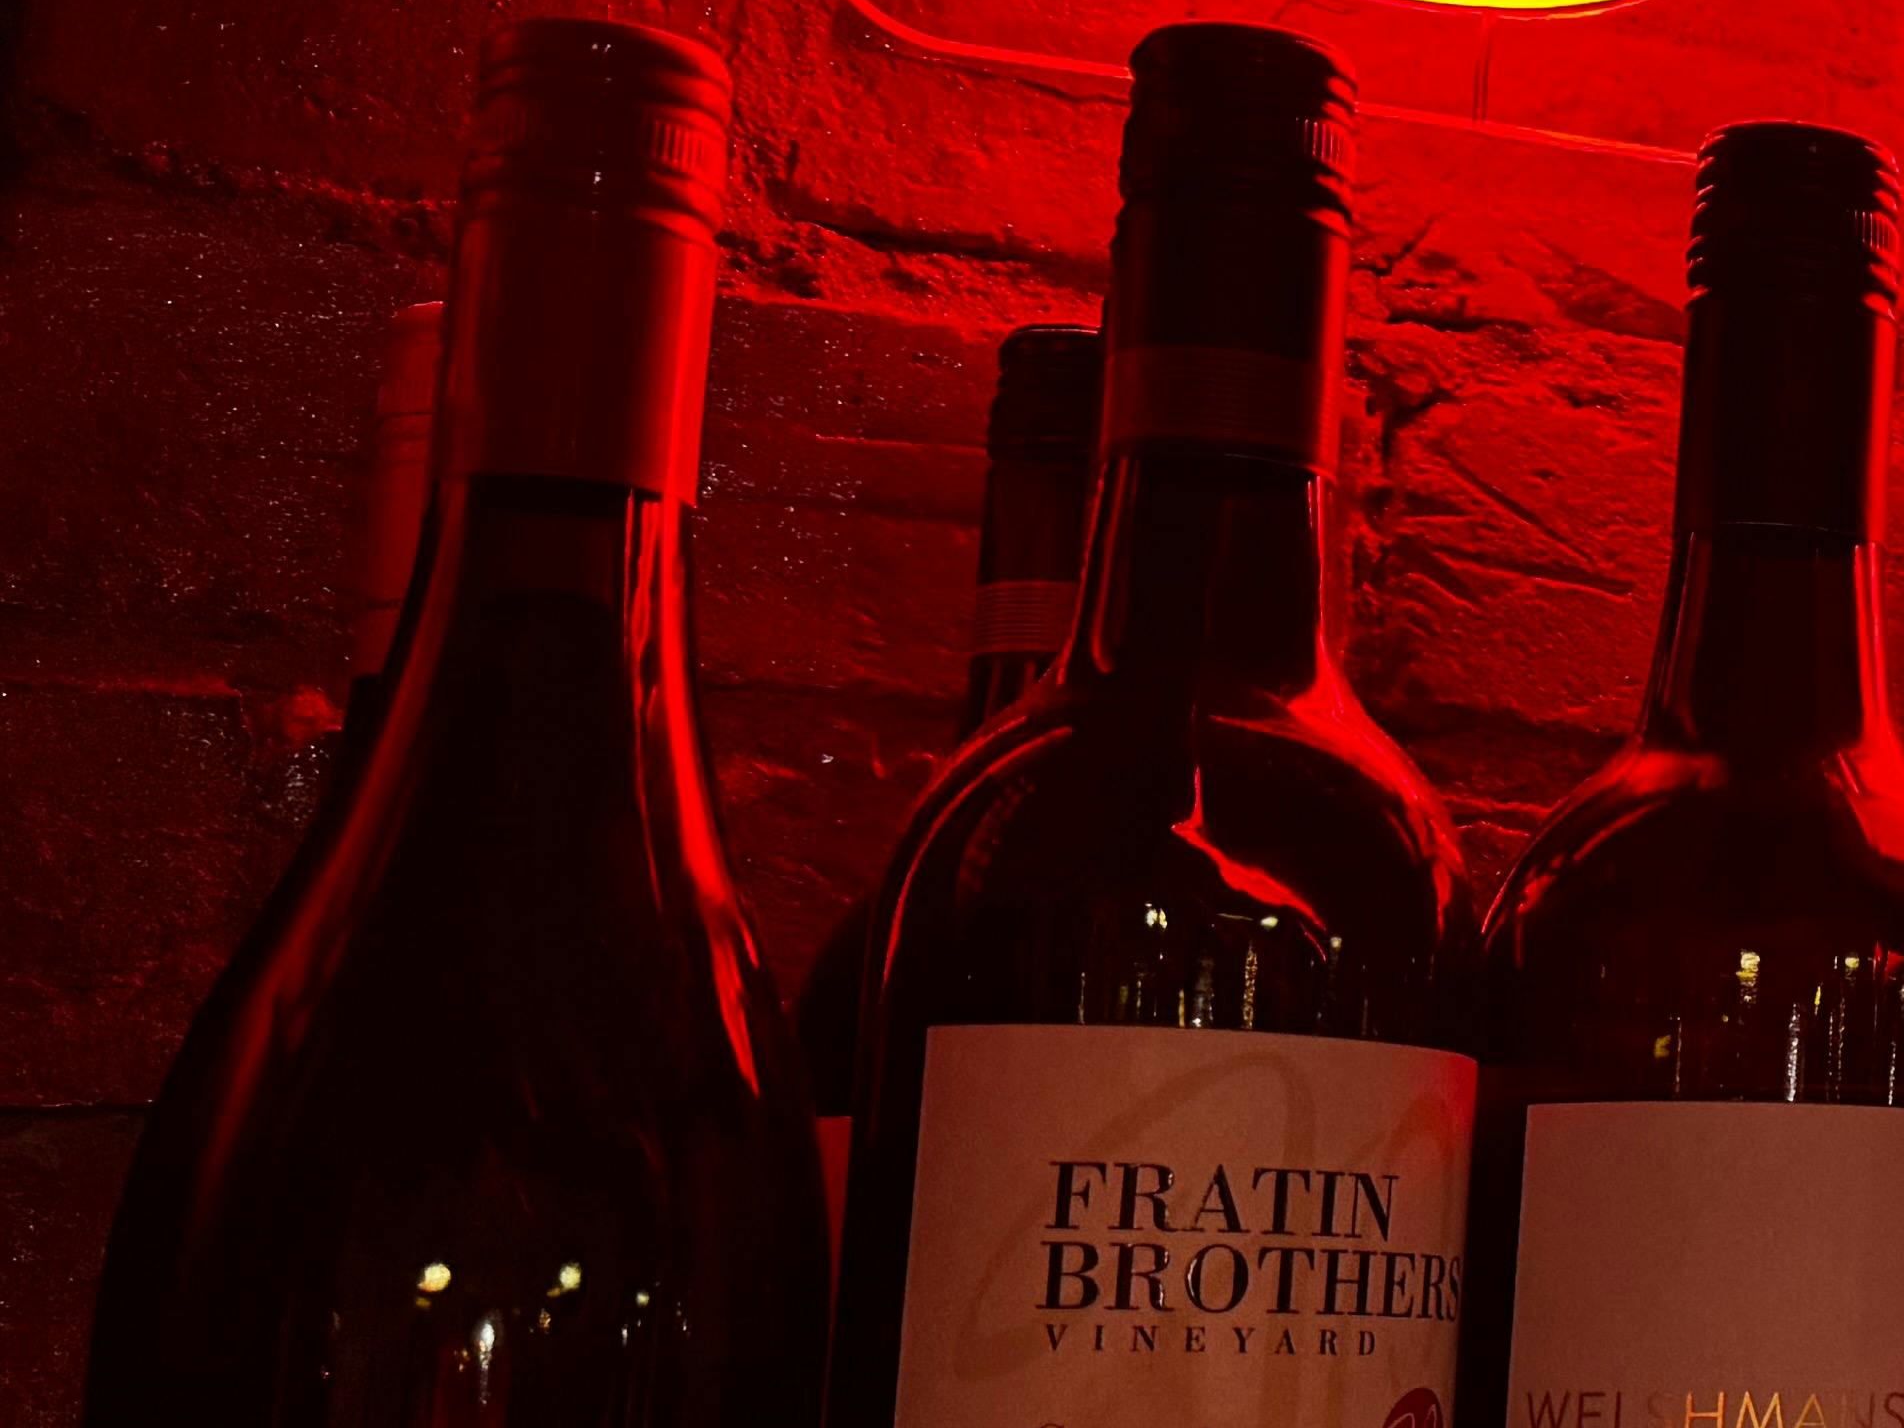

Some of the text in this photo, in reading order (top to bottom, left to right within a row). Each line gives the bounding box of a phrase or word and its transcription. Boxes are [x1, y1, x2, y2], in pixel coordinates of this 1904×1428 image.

[1044, 1160, 1398, 1241] FRATIN
[1036, 1239, 1461, 1324] BROTHERS
[1046, 1324, 1377, 1356] VINEYARD
